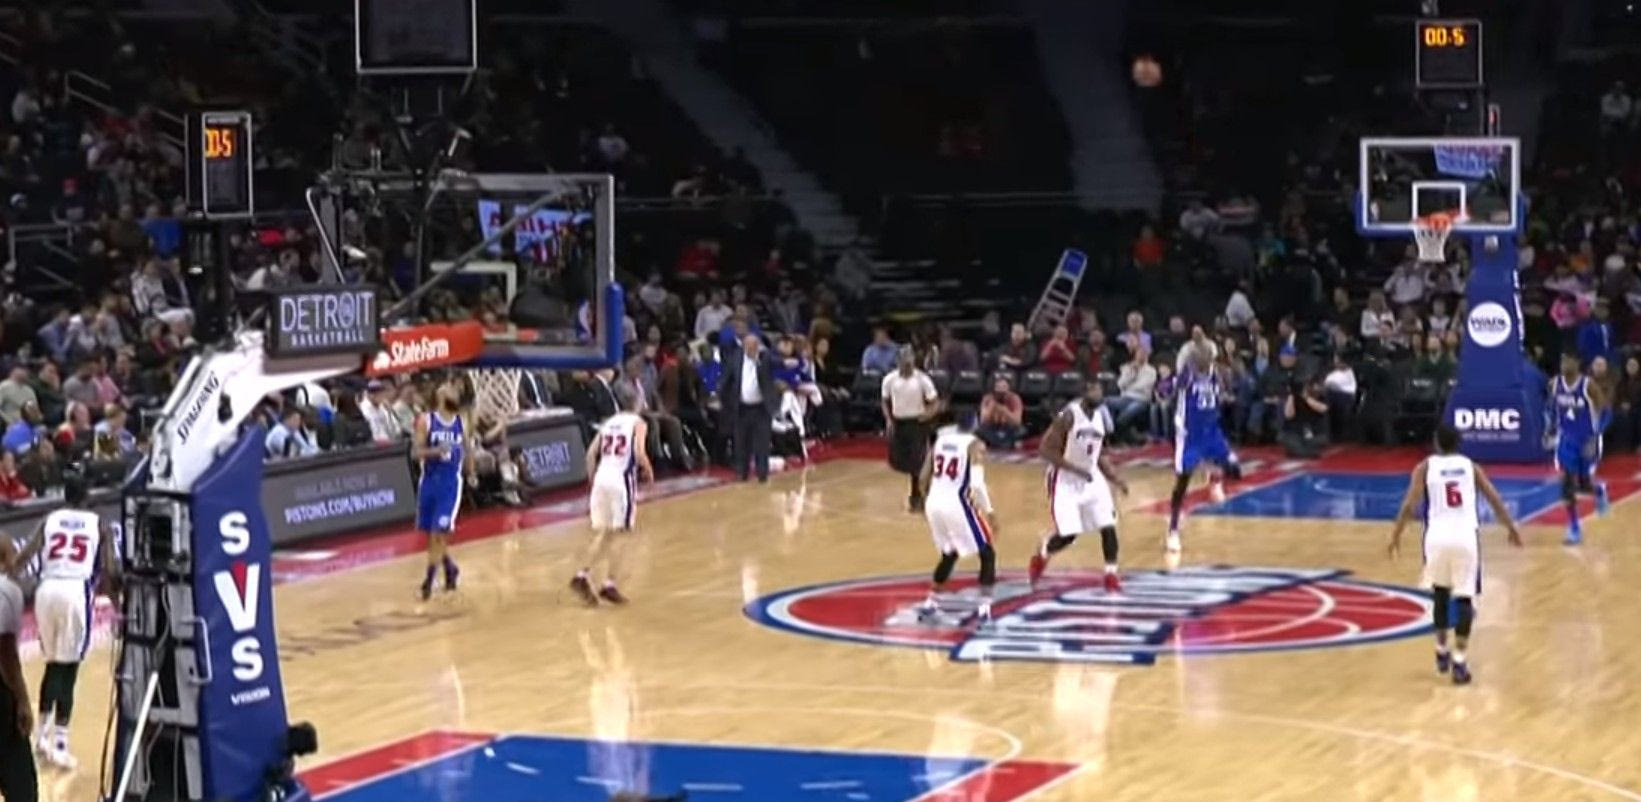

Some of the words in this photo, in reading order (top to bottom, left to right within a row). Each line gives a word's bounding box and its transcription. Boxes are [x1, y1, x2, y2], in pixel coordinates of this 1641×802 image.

[280, 292, 374, 332] DETROIT
[1454, 408, 1520, 430] DMC
[602, 434, 627, 457] 22
[934, 454, 960, 481] 34
[1444, 480, 1463, 508] 6
[48, 531, 90, 563] 25
